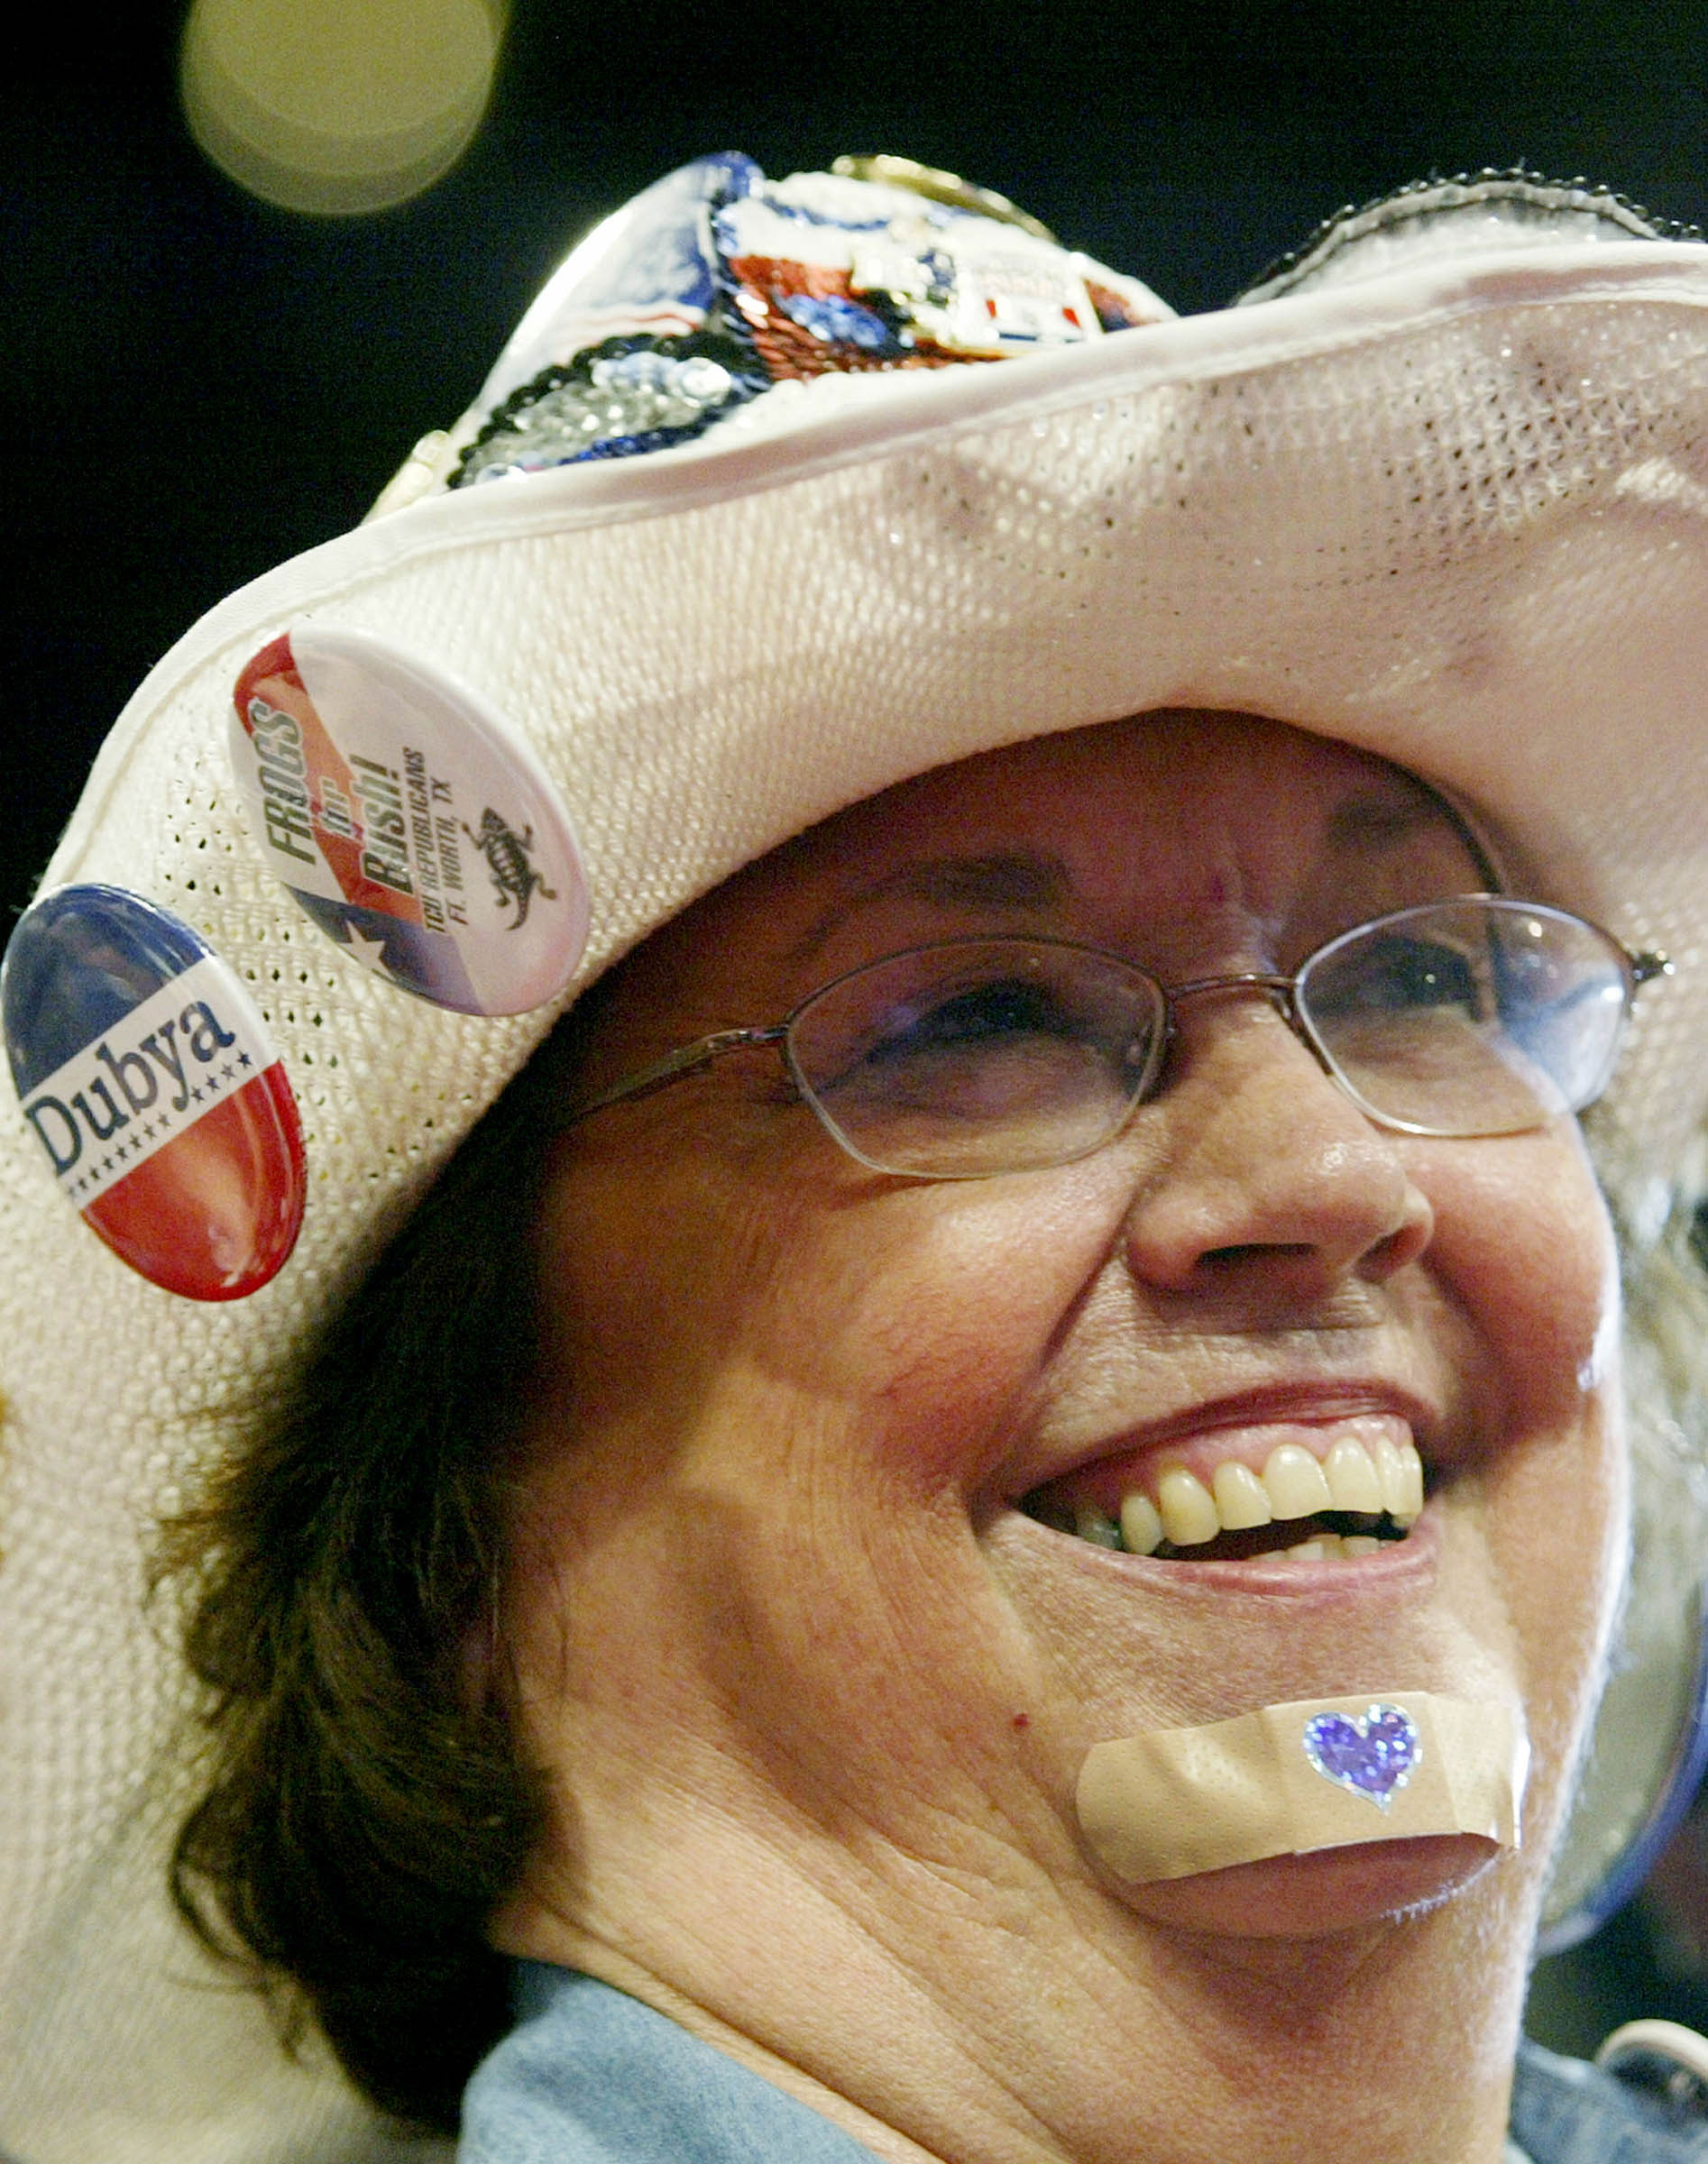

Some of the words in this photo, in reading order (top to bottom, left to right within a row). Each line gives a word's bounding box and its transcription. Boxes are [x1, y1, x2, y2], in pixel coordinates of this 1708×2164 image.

[248, 697, 316, 865] FROGS
[350, 754, 414, 894] Bush!
[403, 747, 439, 891] REPUBLICANS
[431, 777, 453, 804] TX
[424, 894, 446, 932] TCU
[436, 815, 464, 891] WORTH,
[25, 1001, 235, 1176] Dubya
